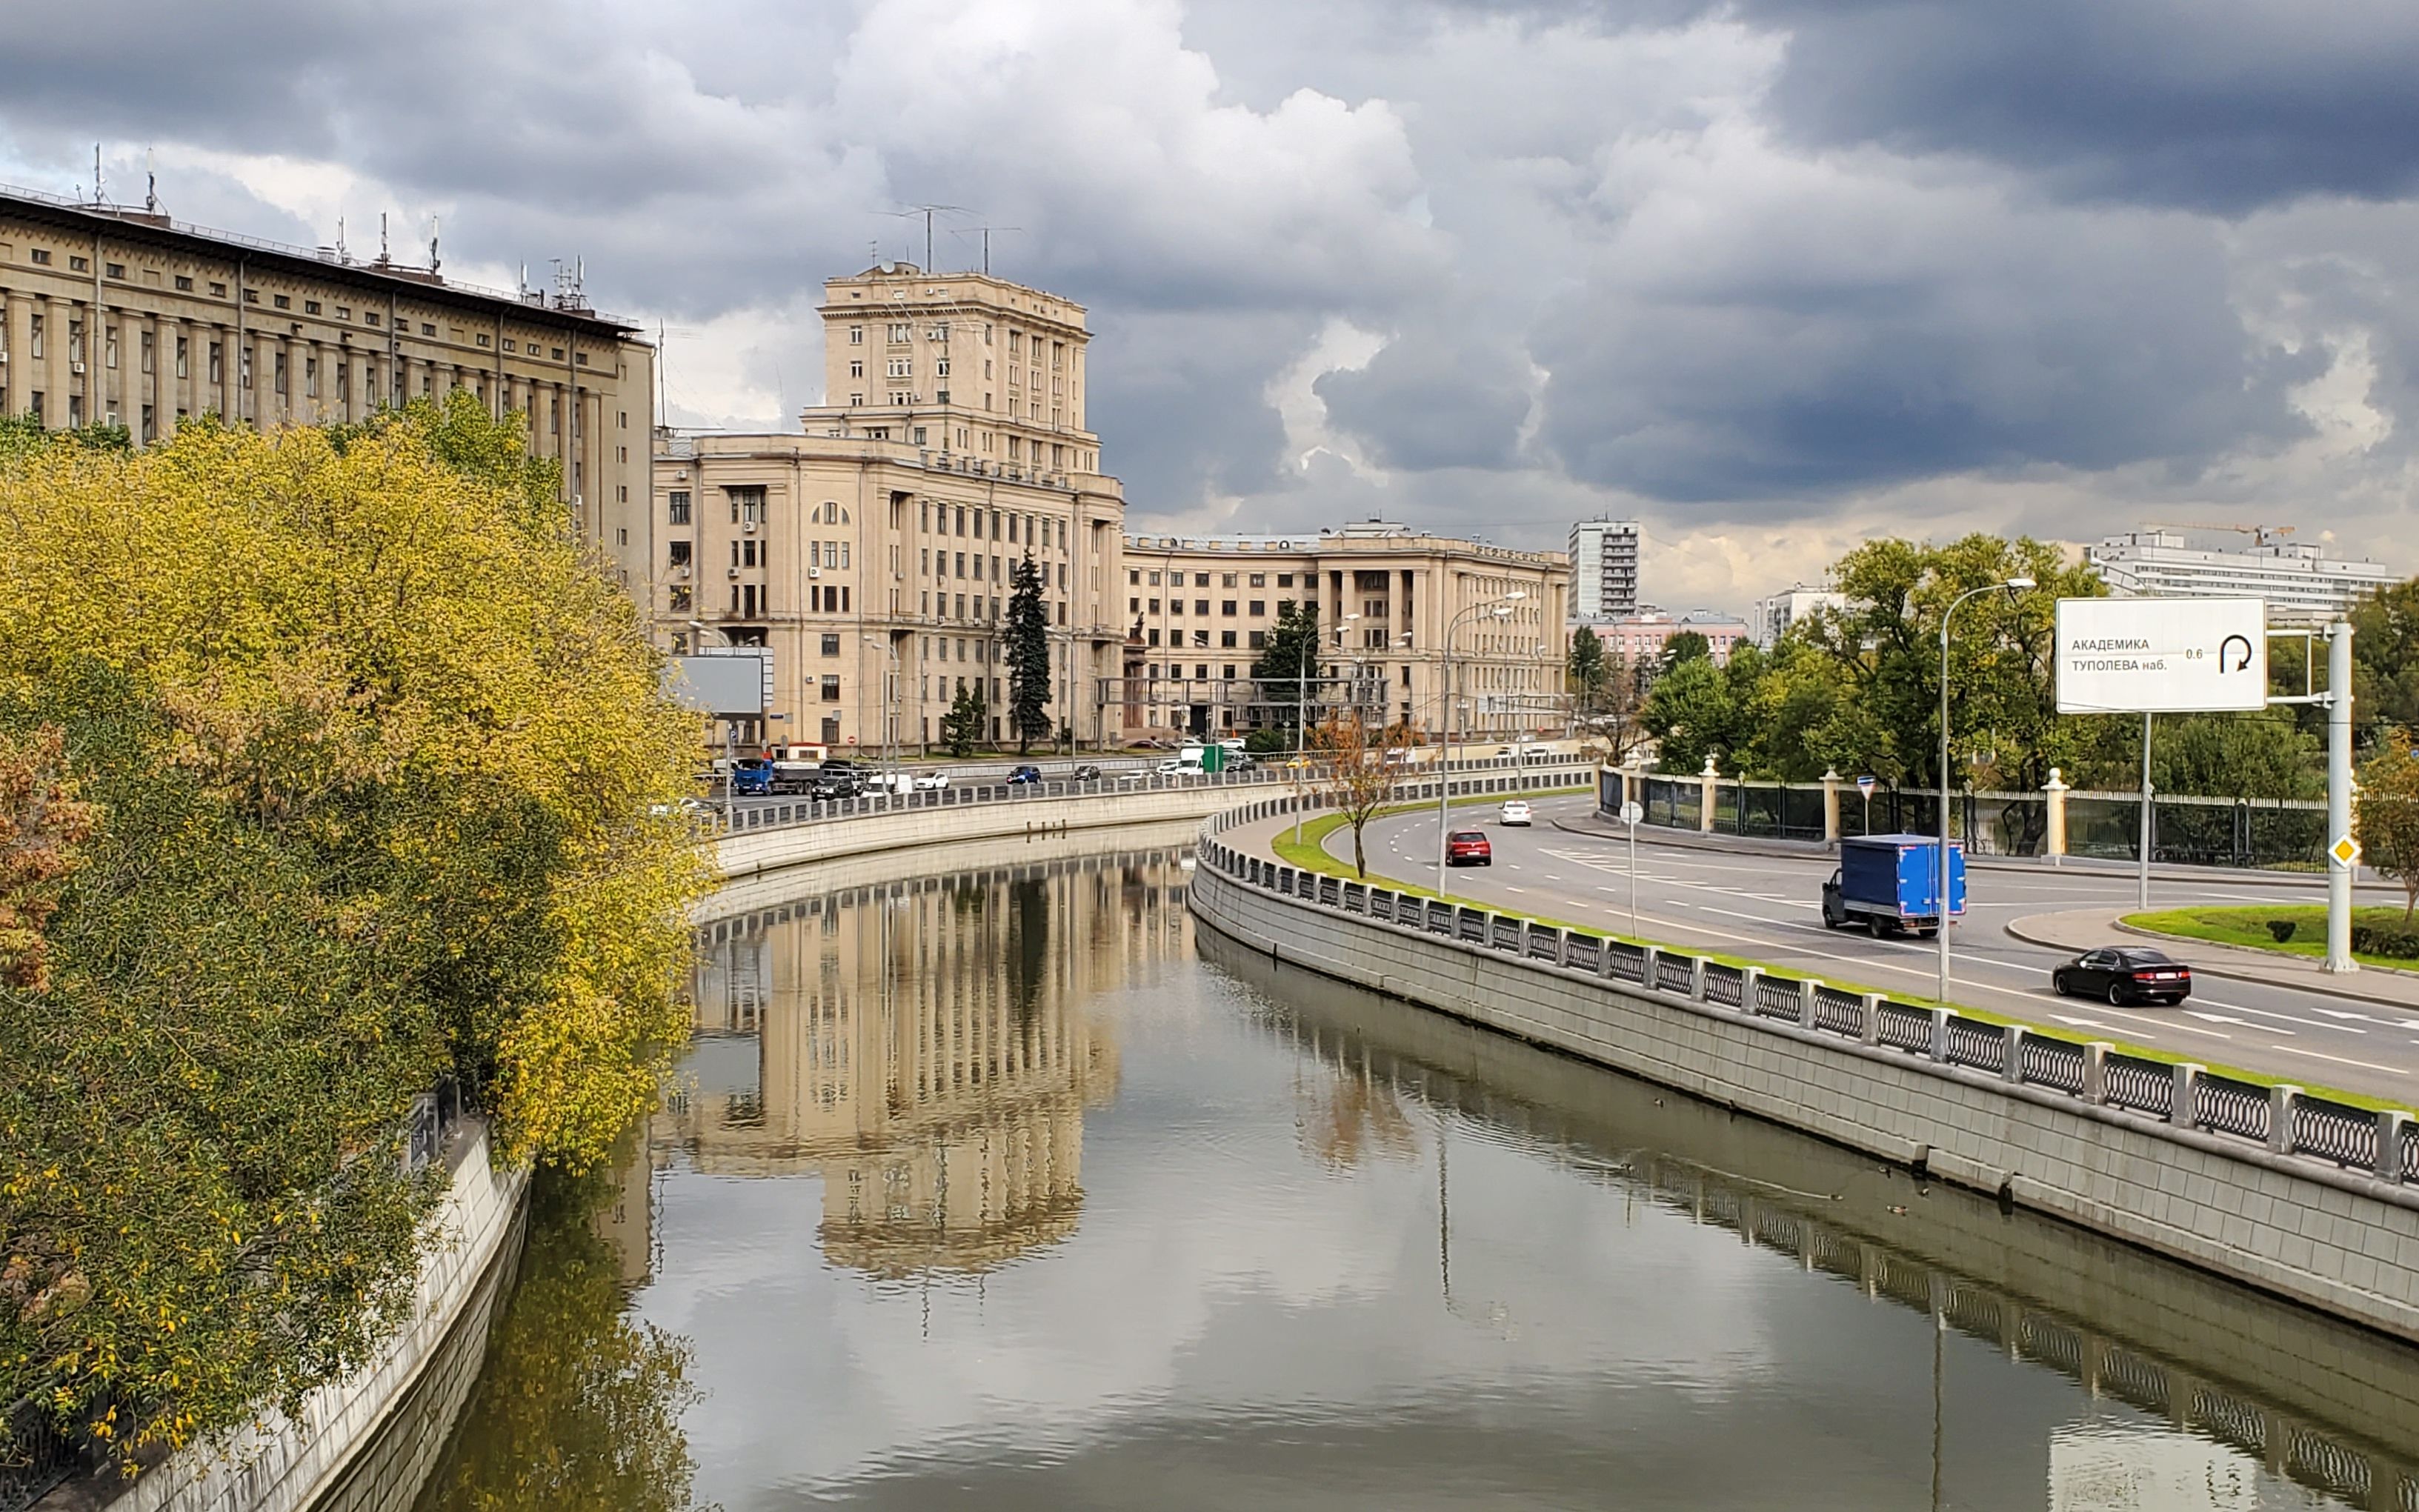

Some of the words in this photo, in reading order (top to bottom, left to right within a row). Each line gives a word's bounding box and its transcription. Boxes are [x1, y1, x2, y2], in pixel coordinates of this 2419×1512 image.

[2072, 639, 2149, 651] АКАДЕМИКА
[2186, 649, 2203, 659] 0.6
[2072, 660, 2139, 670] ТУПОЛЕВА
[2143, 659, 2167, 670] наб.
